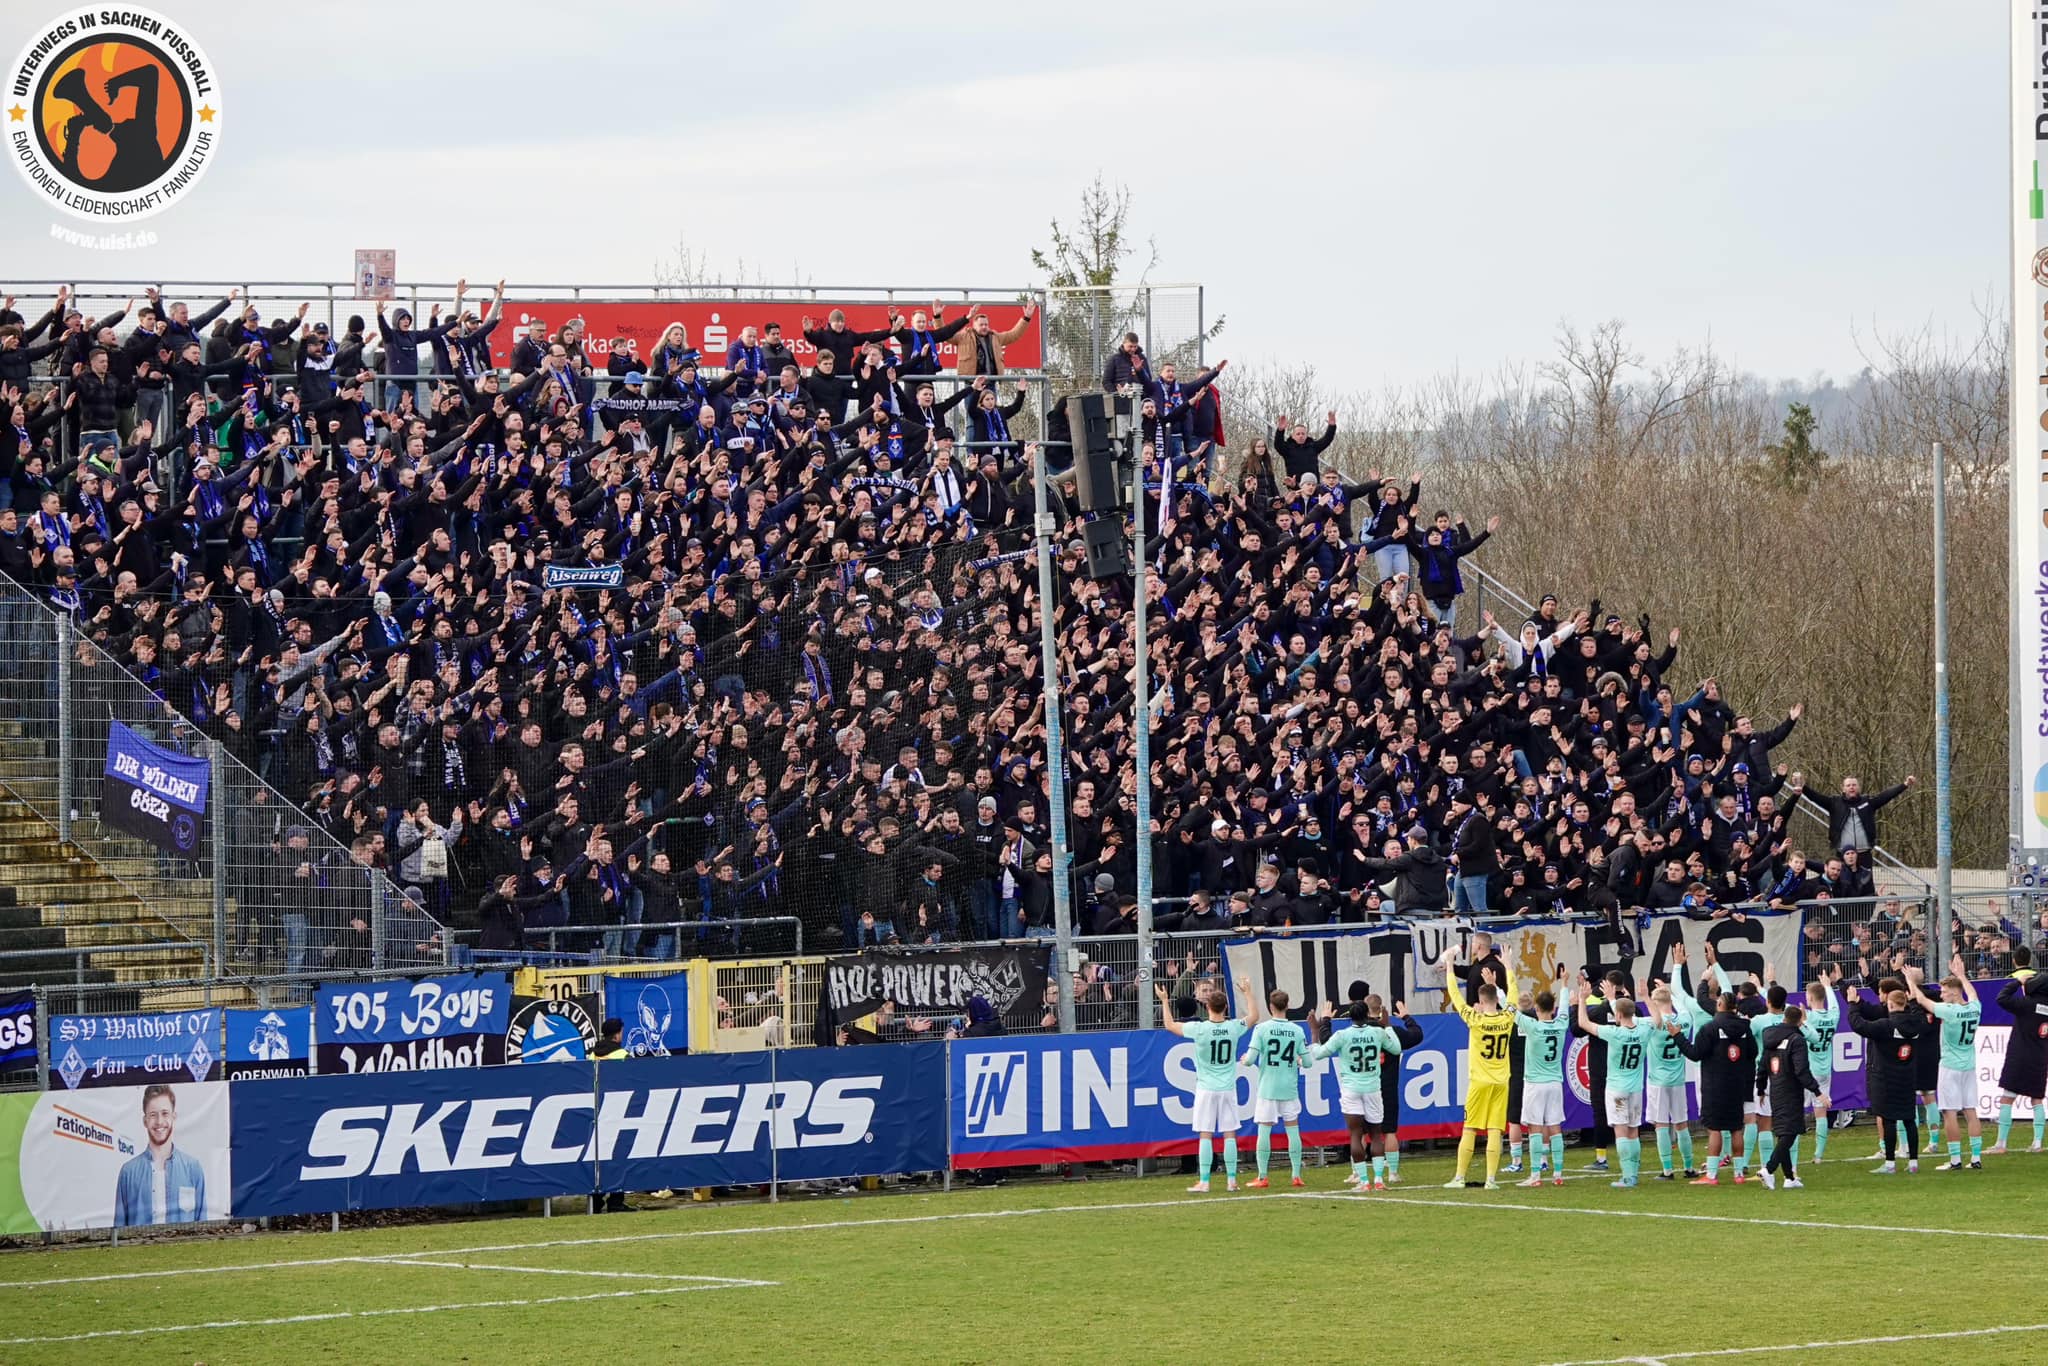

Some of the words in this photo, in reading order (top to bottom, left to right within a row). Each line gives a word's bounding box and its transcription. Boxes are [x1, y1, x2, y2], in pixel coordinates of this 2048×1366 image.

[549, 569, 621, 584] Alsenweg
[141, 764, 200, 804] WILDEN
[550, 982, 573, 1000] 10
[331, 991, 388, 1034] 305
[401, 982, 494, 1035] Boys
[59, 1016, 97, 1042] SV
[103, 1014, 182, 1042] Waldhof
[187, 1012, 212, 1034] 07
[547, 1000, 597, 1051] GAUNE
[1958, 1020, 1978, 1046] 15
[1210, 1039, 1232, 1065] 10
[1267, 1038, 1296, 1067] 24
[1349, 1045, 1378, 1073] 32
[1480, 1034, 1508, 1060] 30
[1544, 1035, 1558, 1062] 3
[1619, 1043, 1642, 1069] 18
[91, 1056, 126, 1078] Fan
[143, 1053, 182, 1072] Club
[56, 1115, 114, 1145] ratiopharm
[299, 1075, 884, 1181] SKECHERS
[118, 1138, 134, 1156] teva
